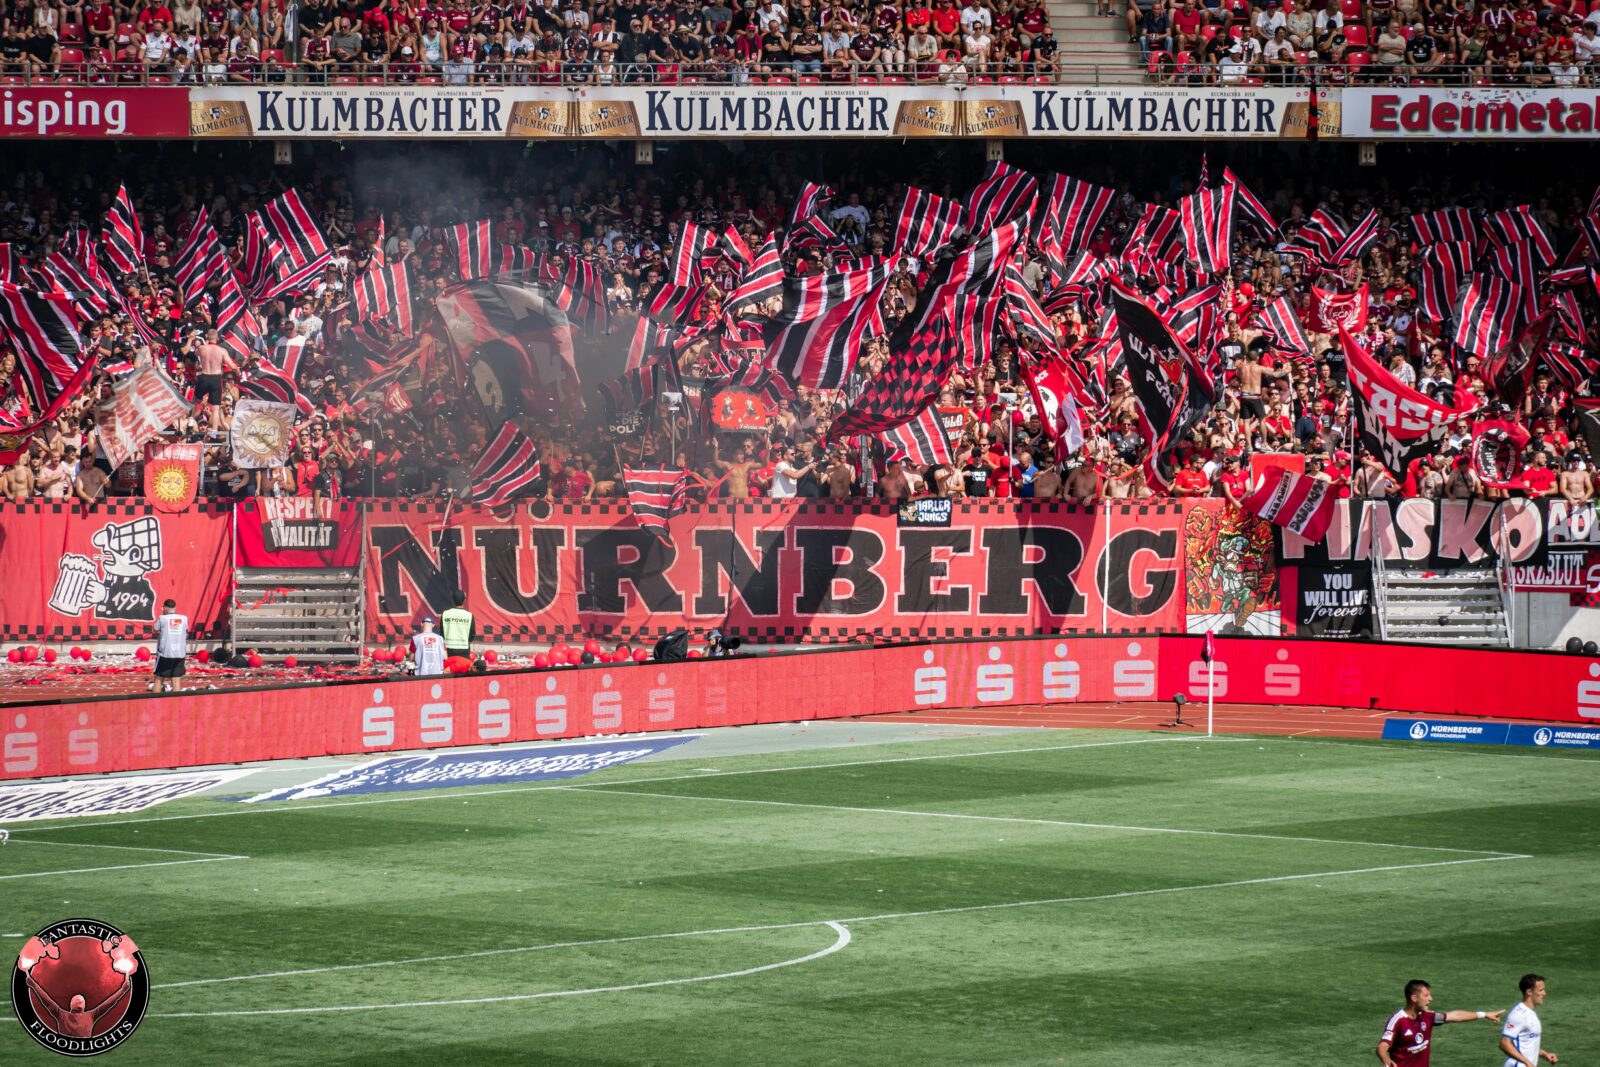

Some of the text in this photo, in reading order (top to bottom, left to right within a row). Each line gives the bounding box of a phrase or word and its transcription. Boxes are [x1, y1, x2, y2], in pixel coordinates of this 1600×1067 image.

[4, 90, 126, 135] isping
[257, 90, 503, 132] KULMBACHER
[646, 90, 890, 132] KULMBACHER
[1032, 90, 1277, 132] KULMBACHER
[190, 114, 247, 135] KULMBACHER
[513, 113, 568, 135] KULMBACHER
[578, 114, 634, 136] KULMBACHER
[901, 113, 956, 134] KULMBACHER
[271, 522, 333, 547] RVALITÄT
[370, 499, 1180, 618] NÜRNBERG
[1323, 573, 1353, 590] YOU
[112, 591, 149, 611] 1994
[1304, 590, 1339, 606] WILL
[1303, 601, 1366, 625] forever
[1430, 725, 1483, 734] NÜRNBERGER
